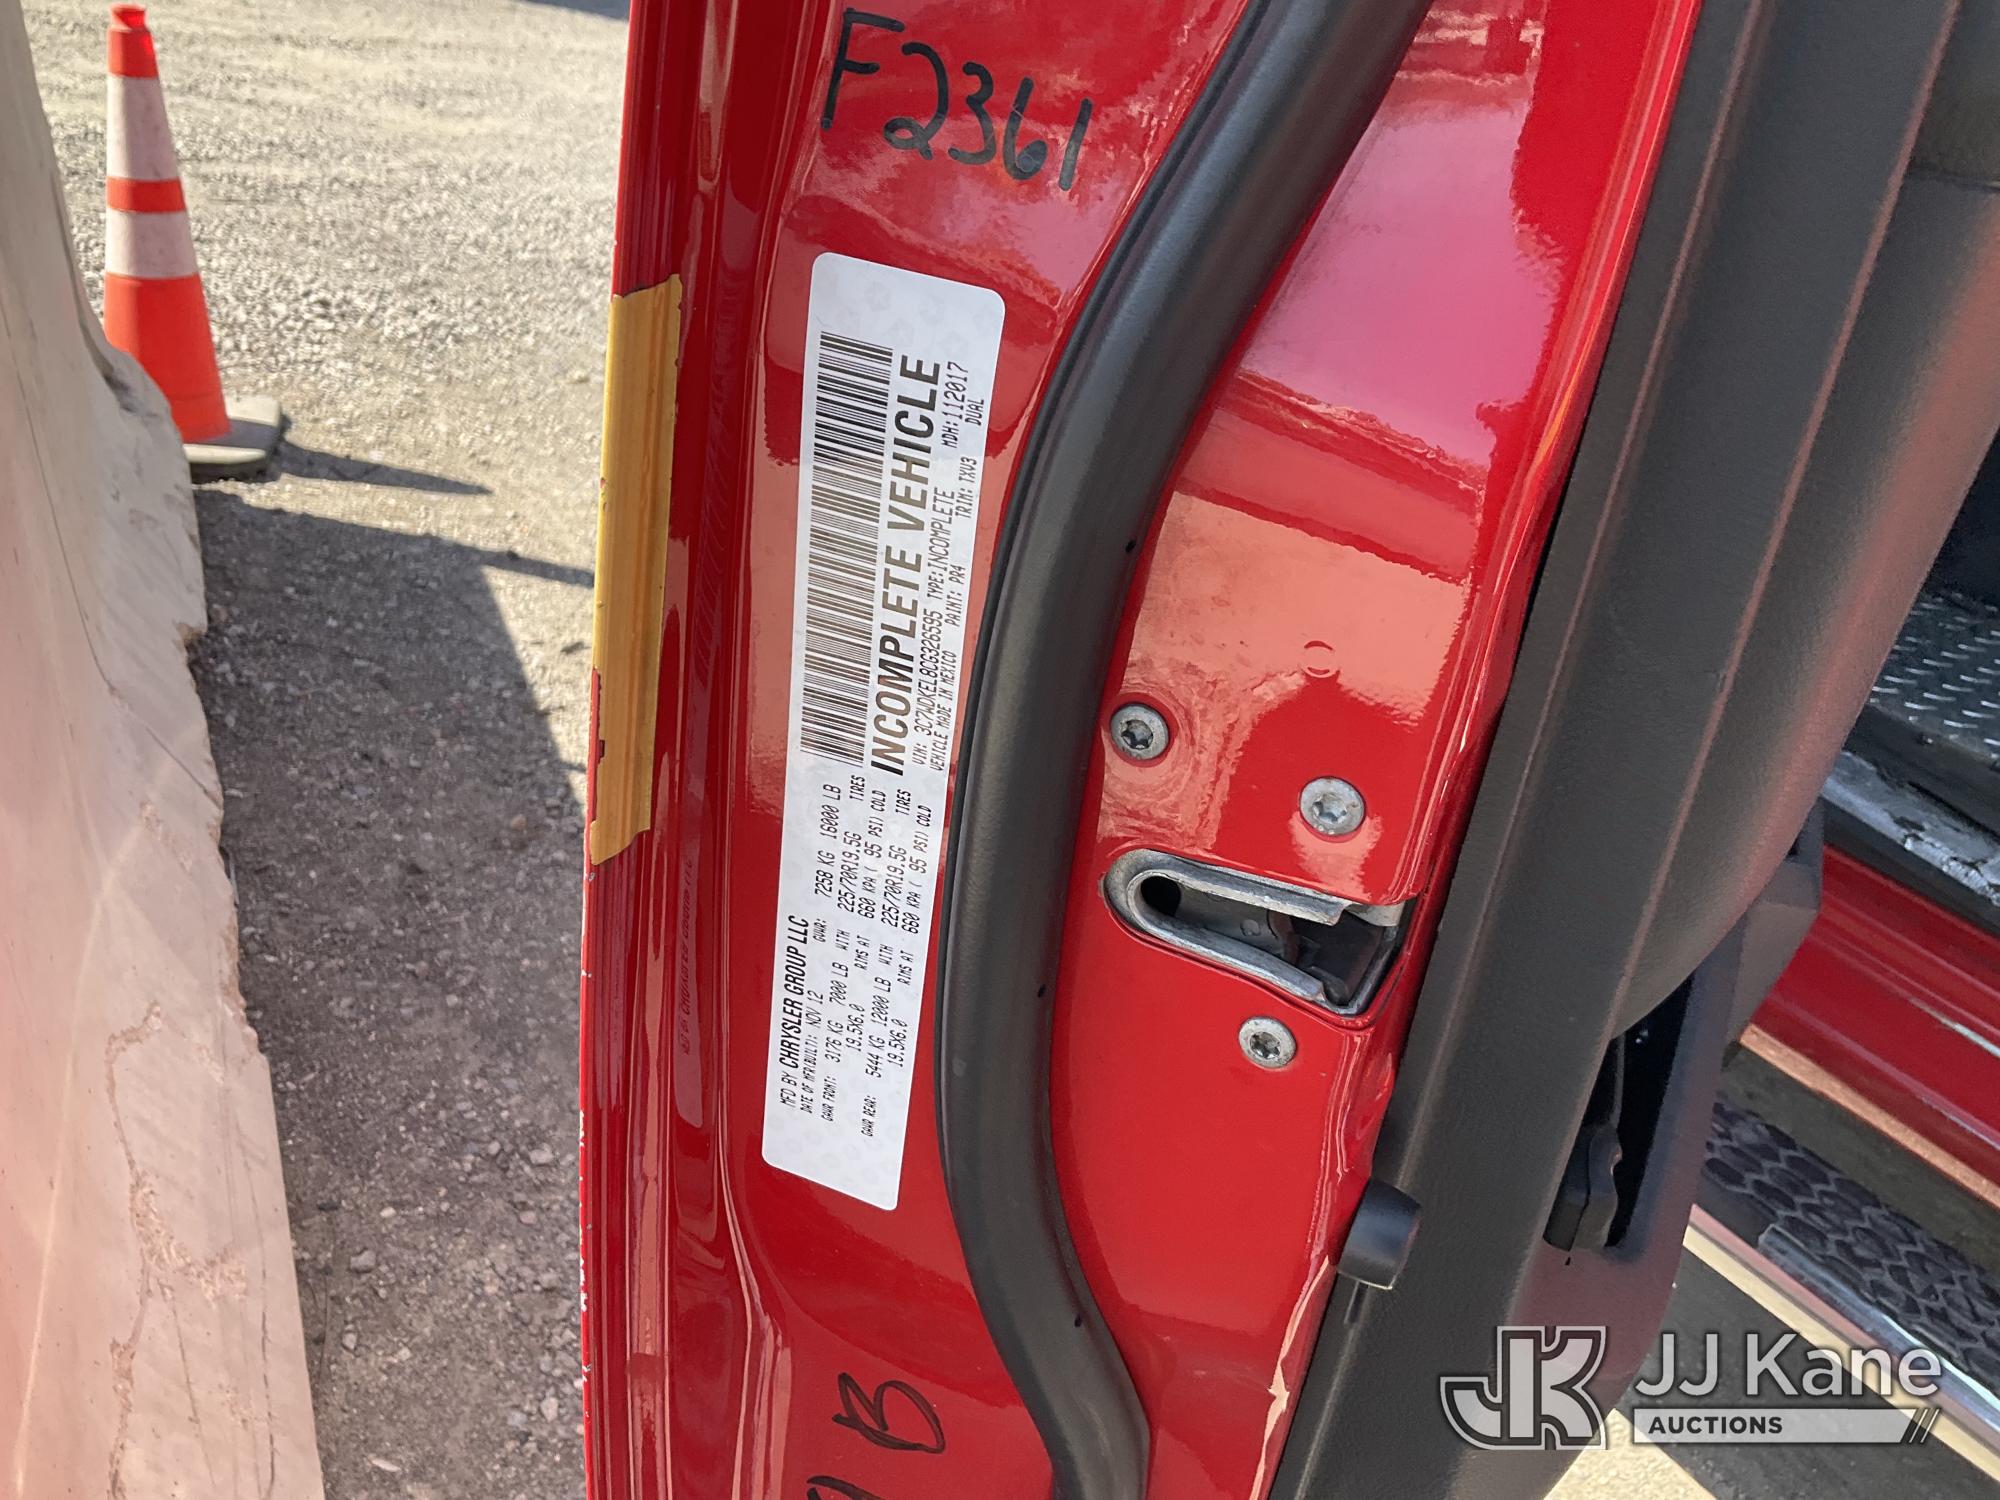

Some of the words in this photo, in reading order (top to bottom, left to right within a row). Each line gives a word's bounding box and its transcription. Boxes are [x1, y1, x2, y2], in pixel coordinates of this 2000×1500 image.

[820, 7, 1094, 191] F2361
[964, 399, 985, 426] DUAL
[887, 355, 940, 531] VEHICLE
[958, 456, 978, 484] TXV3
[954, 487, 974, 519] TRIM:
[948, 564, 966, 585] PR4
[944, 590, 963, 627] PAINT:
[871, 546, 921, 775] INCOMPLETE
[939, 650, 957, 686] MEXICO
[937, 687, 954, 702] IN
[935, 703, 952, 730] MADE
[912, 742, 928, 765] VIN:
[929, 730, 949, 772] VEHICLE
[822, 783, 842, 801] LB
[849, 774, 866, 802] TIRES
[870, 789, 887, 812] COLD
[895, 788, 911, 816] TIRES
[819, 804, 840, 840] 16000
[916, 804, 932, 828] COLD
[817, 850, 836, 868] KG
[863, 841, 883, 859] 95
[837, 831, 862, 913] 225/70R19.5G
[908, 855, 928, 874] 95
[814, 869, 834, 898] 7258
[861, 876, 877, 894] KPA
[880, 845, 907, 928] 225/70R19.5G
[857, 896, 876, 919] 660
[906, 891, 921, 909] KPA
[787, 915, 809, 945] LLC
[901, 911, 920, 934] 660
[835, 928, 850, 951] WITH
[856, 934, 870, 948] AT
[853, 948, 869, 971] RIMS
[878, 943, 893, 966] WITH
[899, 949, 914, 963] AT
[783, 945, 807, 996] GROUP
[831, 961, 849, 978] LB
[896, 963, 913, 986] RIMS
[828, 980, 847, 1006] 7000
[874, 976, 892, 993] LB
[806, 989, 824, 1005] 12
[804, 1006, 822, 1029] NOV
[870, 994, 890, 1027] 12000
[779, 997, 803, 1069] CHRYSLER
[826, 1019, 844, 1036] KG
[845, 1003, 865, 1052] 19.5X6.0
[824, 1036, 842, 1063] 3176
[868, 1034, 886, 1051] KG
[887, 1018, 908, 1068] 19.5X6.0
[865, 1052, 883, 1078] 5444
[781, 1070, 798, 1087] BY
[801, 1082, 815, 1094] OF
[822, 1075, 836, 1103] FRONT:
[779, 1087, 797, 1108] MFD
[799, 1094, 814, 1114] DATE
[862, 1095, 877, 1118] REAR:
[820, 1103, 834, 1122] GAWR
[860, 1118, 874, 1137] GAWR
